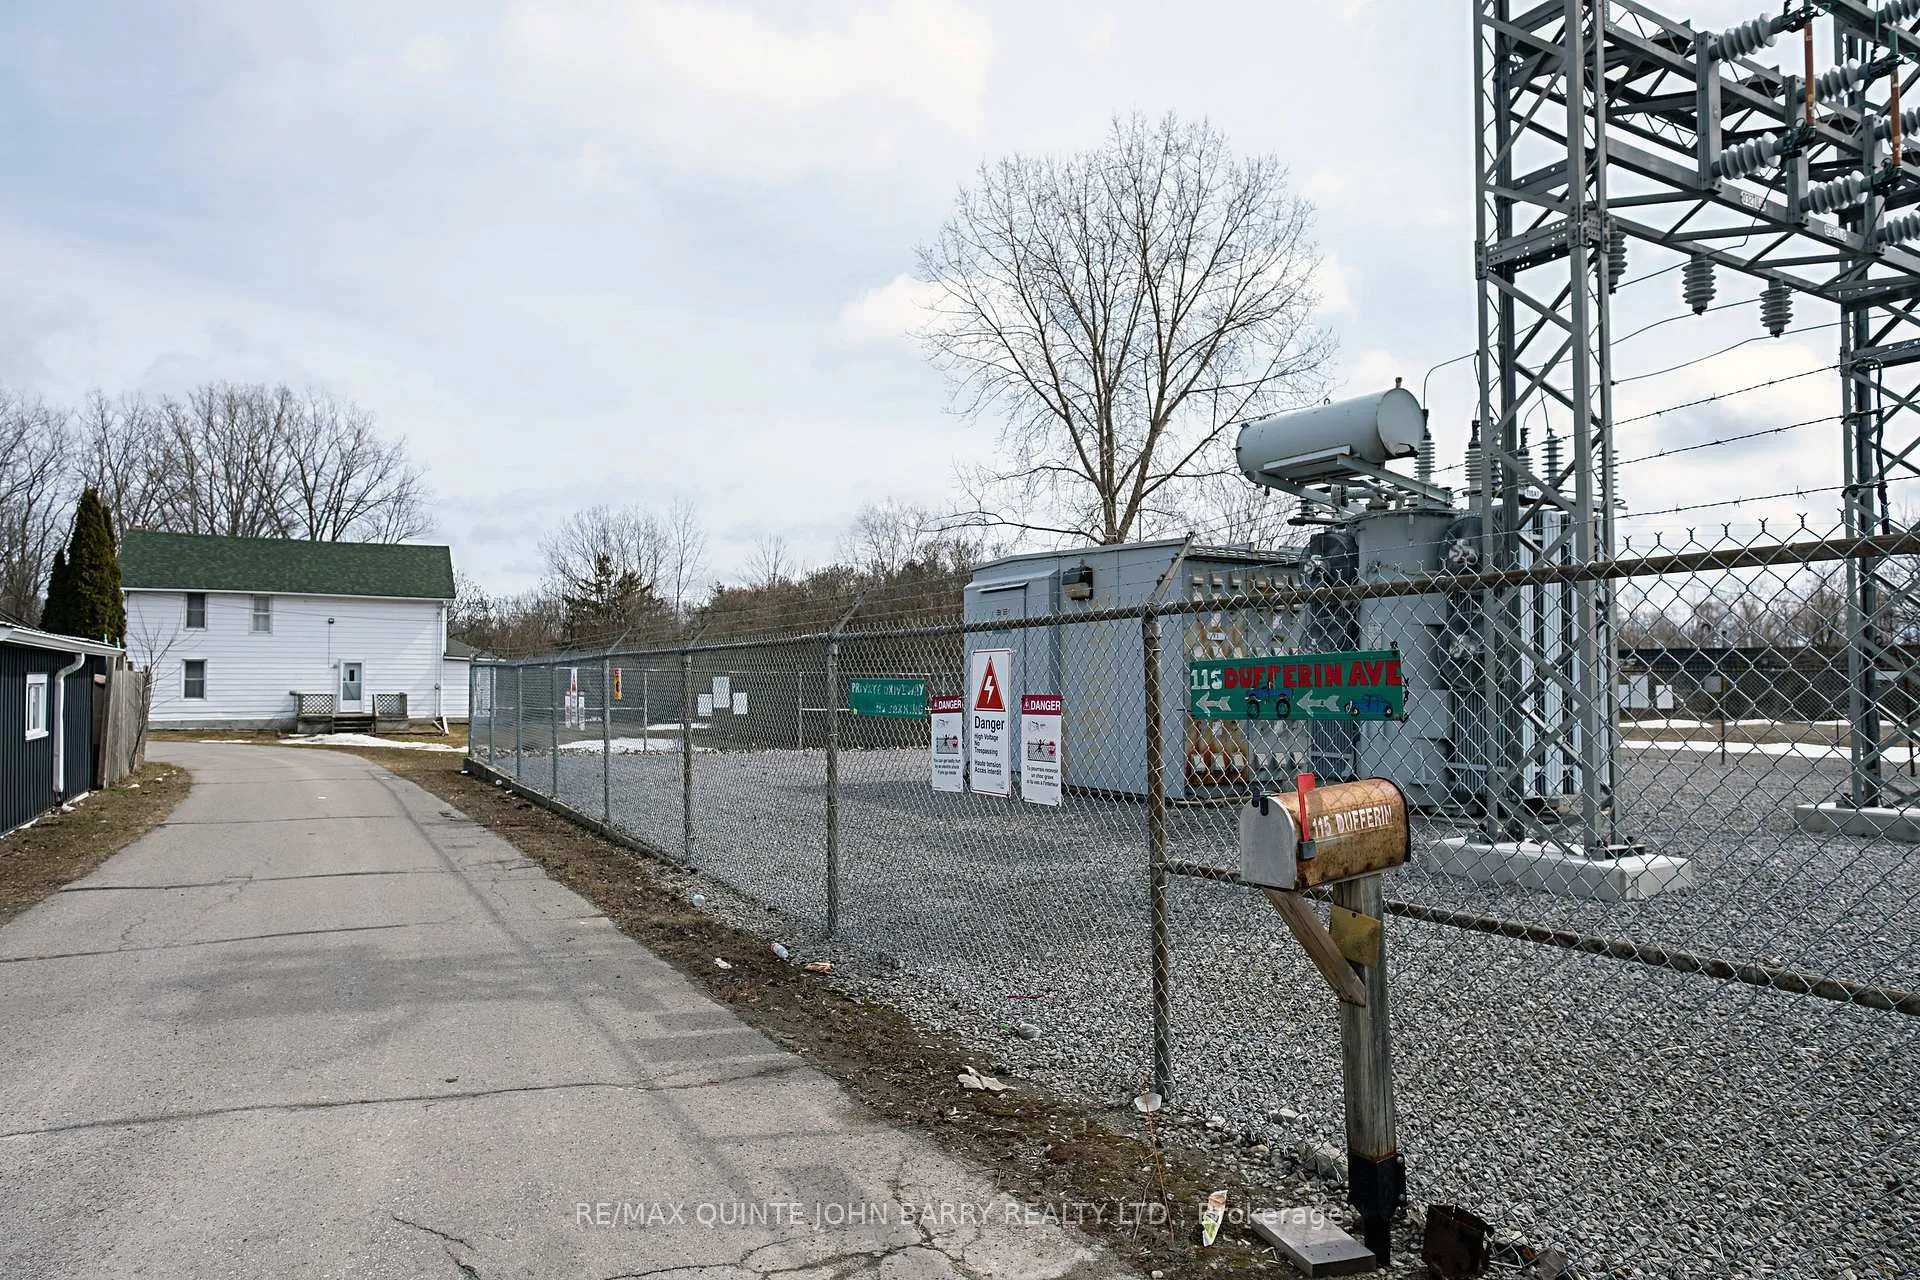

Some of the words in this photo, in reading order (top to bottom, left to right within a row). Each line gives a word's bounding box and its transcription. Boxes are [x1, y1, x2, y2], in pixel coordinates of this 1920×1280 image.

[1190, 668, 1222, 690] 115
[1223, 663, 1343, 690] DUFFERIN
[1348, 659, 1401, 687] AVE
[938, 700, 962, 709] DANGER
[1030, 700, 1061, 711] DANGER
[974, 715, 1005, 733] Danger
[1312, 815, 1332, 838] 115
[1335, 804, 1393, 833] DUFFERIN
